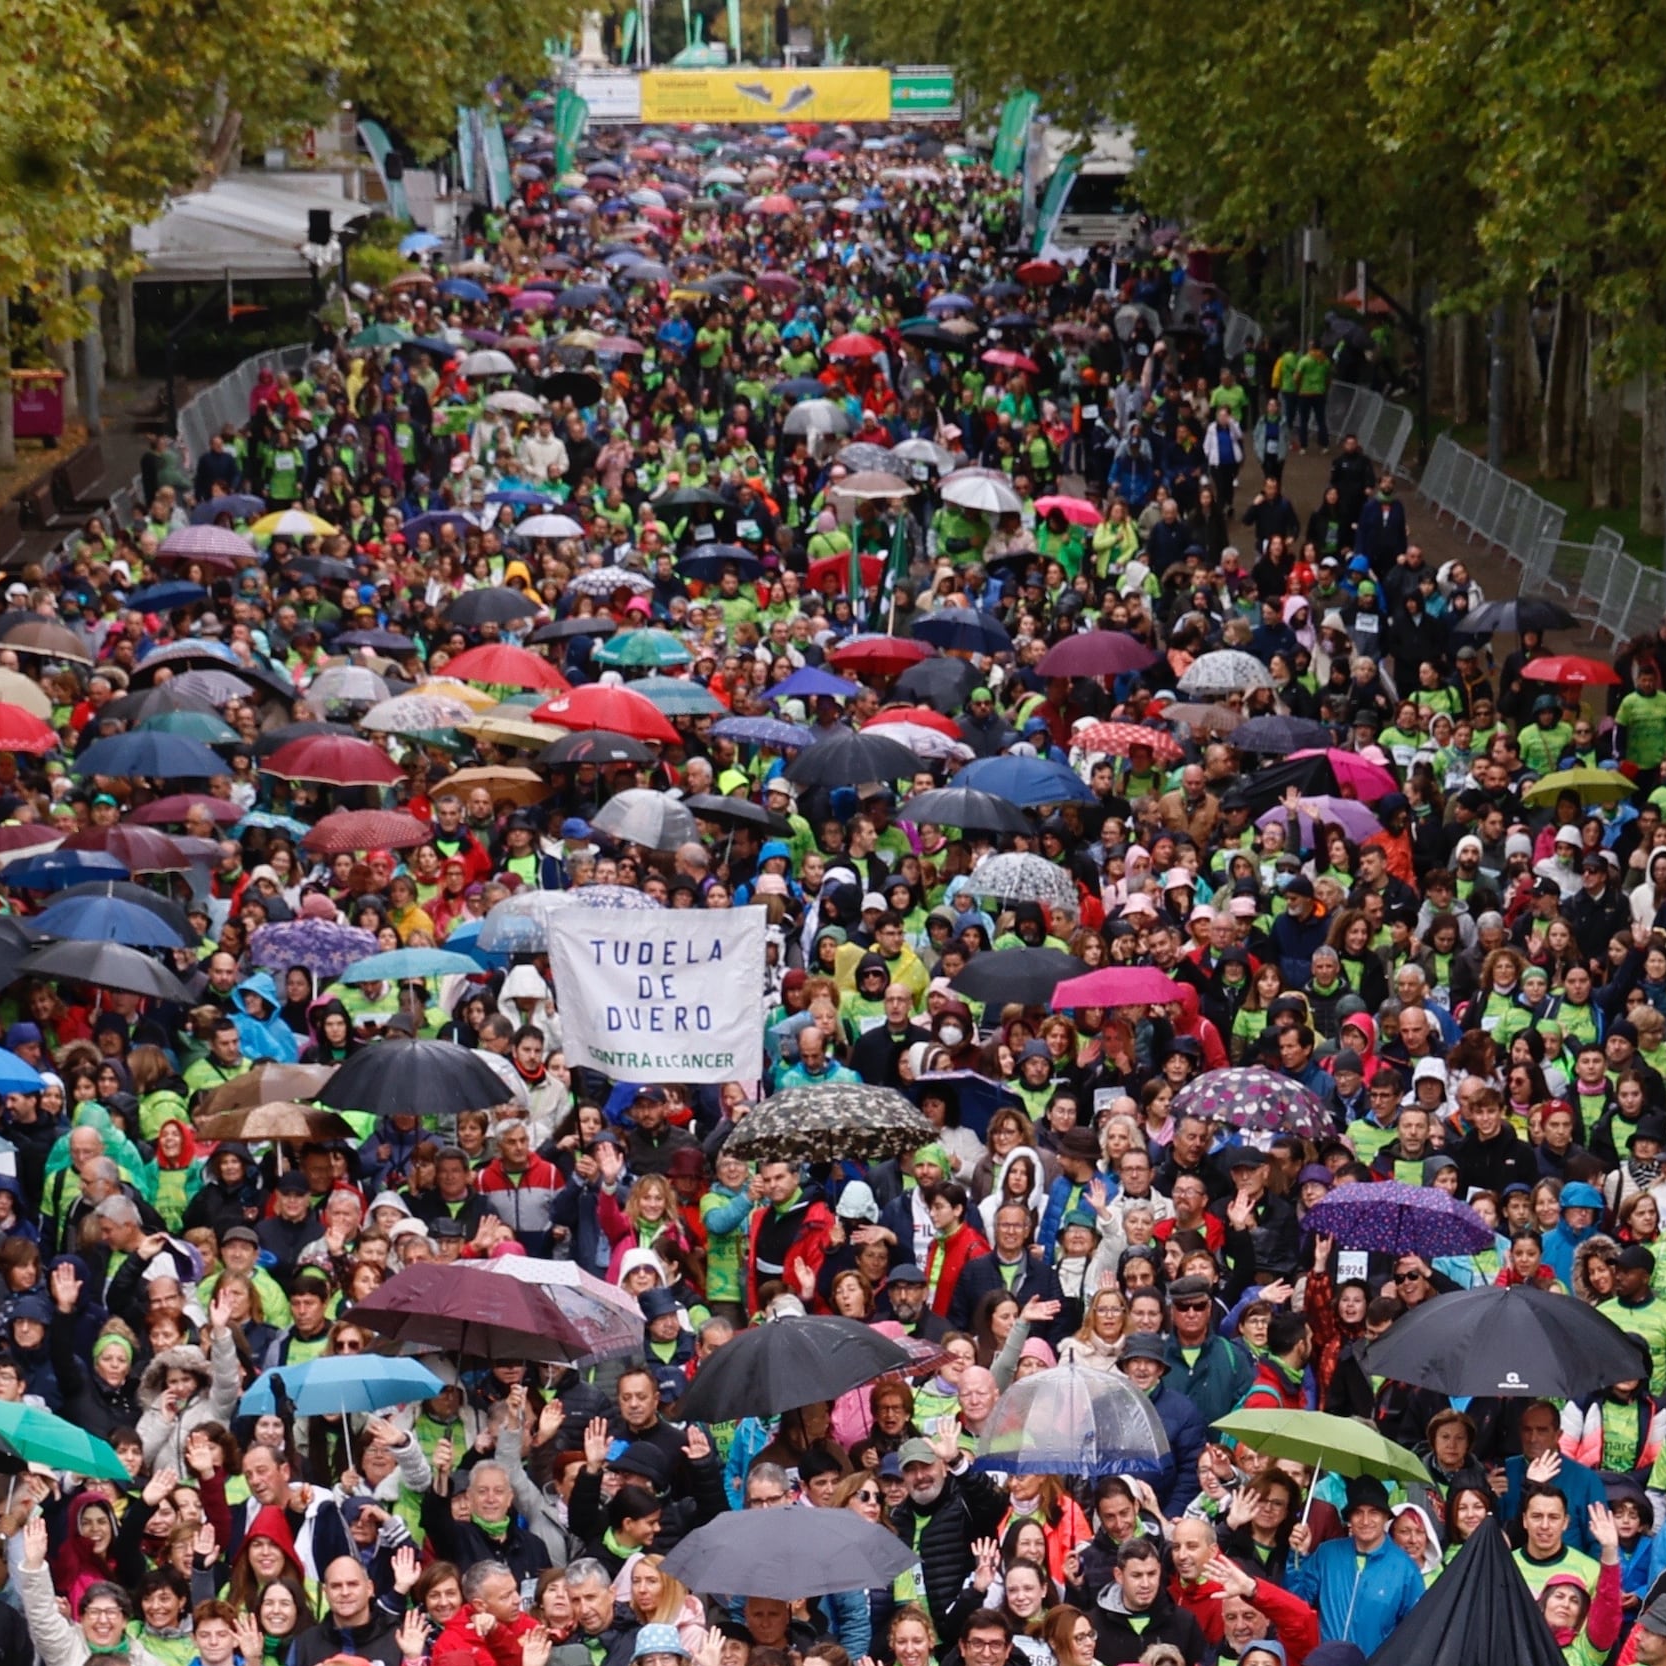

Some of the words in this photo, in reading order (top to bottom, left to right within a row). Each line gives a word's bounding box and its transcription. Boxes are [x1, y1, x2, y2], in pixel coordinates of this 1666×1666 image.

[590, 939, 724, 967] TUDELA
[638, 974, 678, 1000] DE
[607, 1005, 712, 1033] DUERO
[588, 1046, 653, 1068] CONTRA
